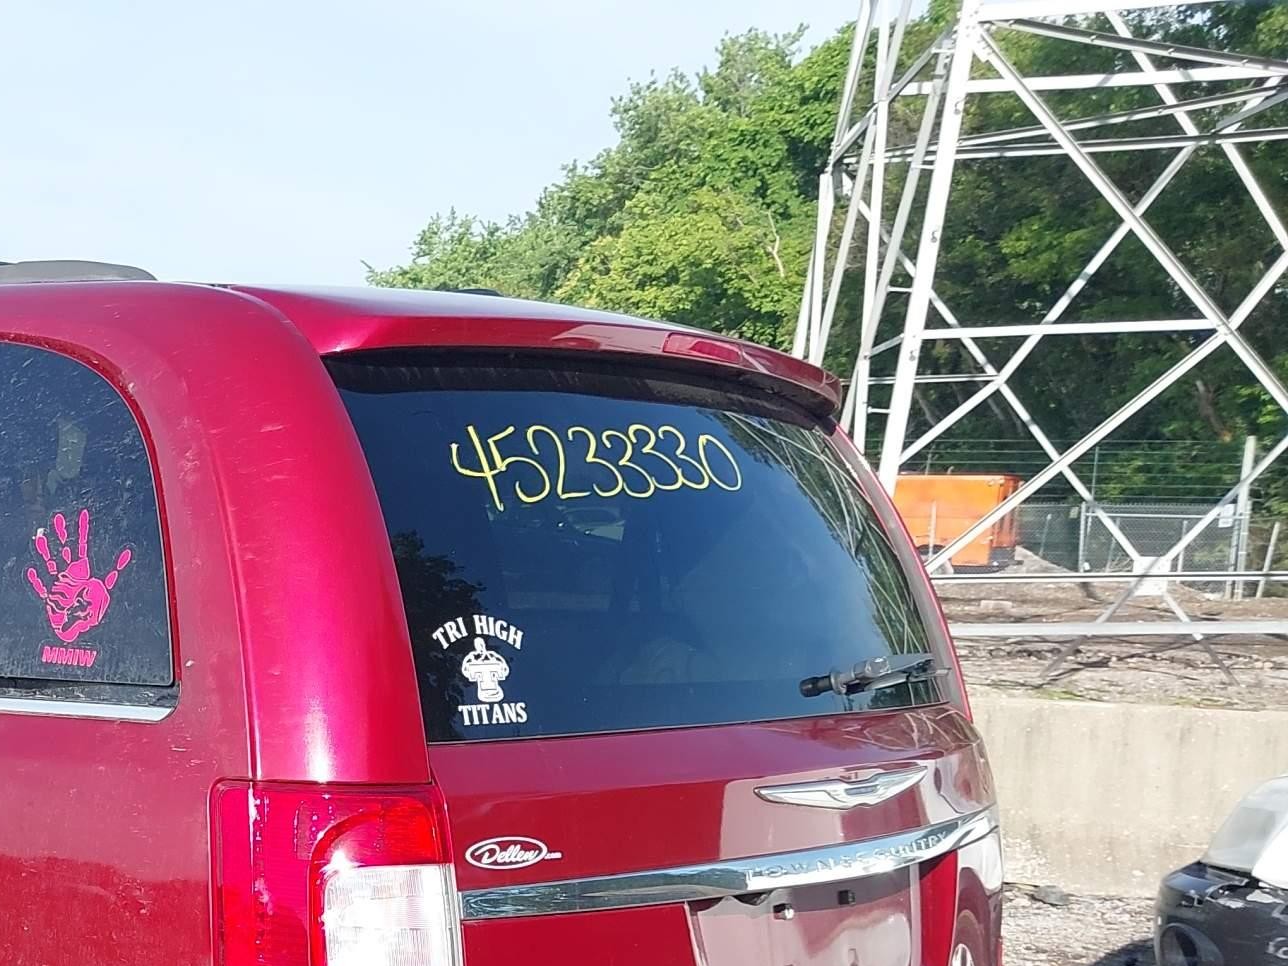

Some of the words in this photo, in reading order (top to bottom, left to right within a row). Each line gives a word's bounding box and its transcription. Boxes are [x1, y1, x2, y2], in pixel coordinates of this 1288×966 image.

[451, 424, 742, 511] 45233330
[432, 616, 468, 649] TRI
[473, 615, 524, 649] HIGH
[42, 646, 97, 667] MMIW
[458, 702, 528, 725] TITANS
